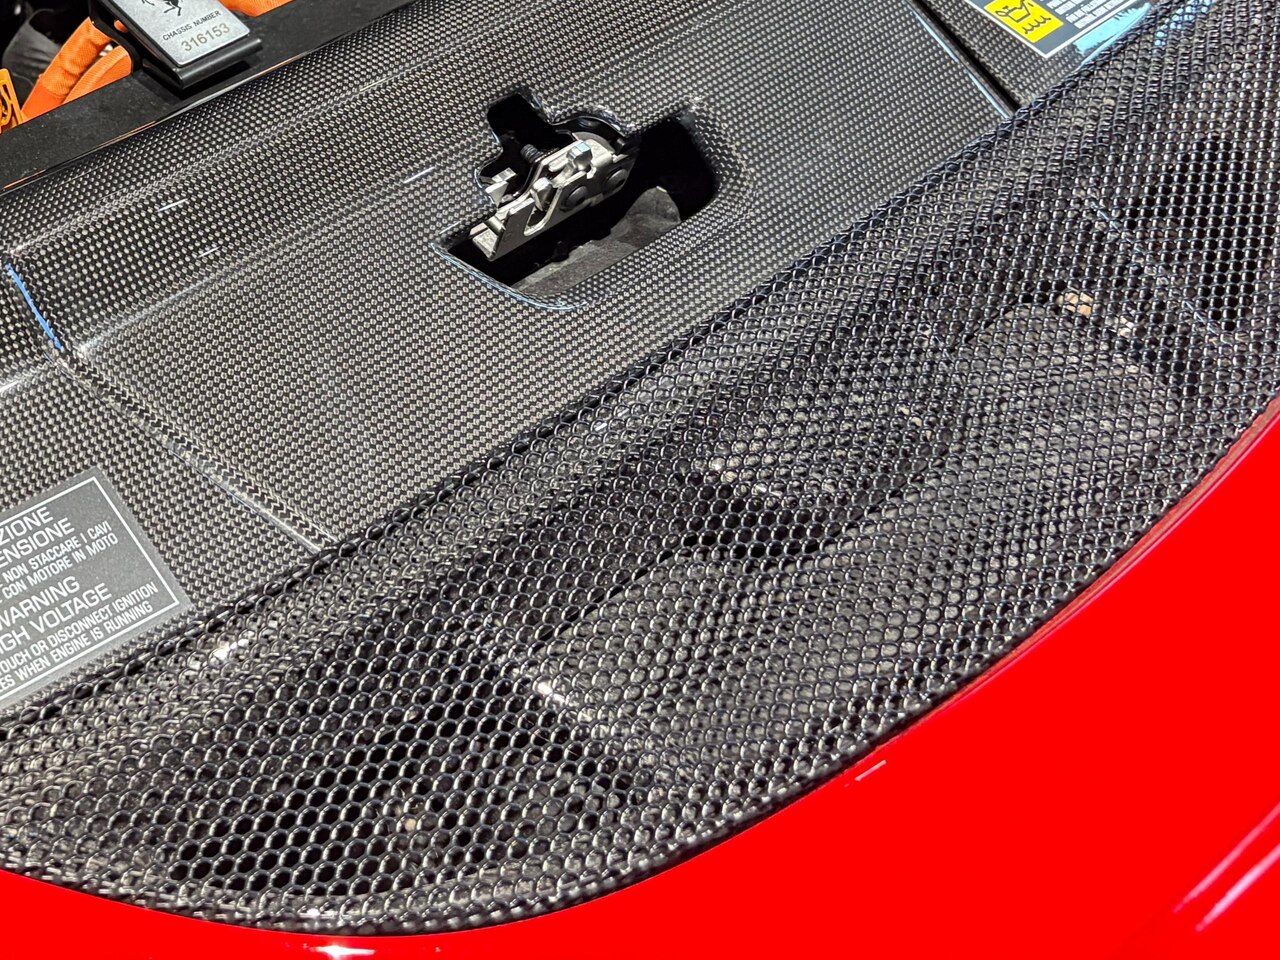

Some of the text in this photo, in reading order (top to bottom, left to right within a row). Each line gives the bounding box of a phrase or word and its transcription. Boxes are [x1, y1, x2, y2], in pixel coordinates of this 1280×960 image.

[162, 11, 221, 41] CHASSIS NUMBER
[181, 23, 230, 51] 316153
[2, 563, 29, 583] NON
[28, 536, 81, 570] STACCARE
[80, 533, 87, 543] I
[87, 520, 112, 539] CAVI
[2, 579, 28, 599] CON
[26, 555, 73, 586] MOTORE
[71, 549, 86, 563] IN
[85, 532, 118, 556] MOTO
[29, 582, 112, 633] VOLTAGE
[30, 640, 49, 656] OR
[46, 604, 113, 648] DISCONNECT
[112, 581, 158, 613] IGNITION
[14, 655, 51, 681] WHEN
[49, 633, 91, 663] ENGINE
[90, 627, 104, 641] IS
[103, 600, 153, 634] RUNNING
